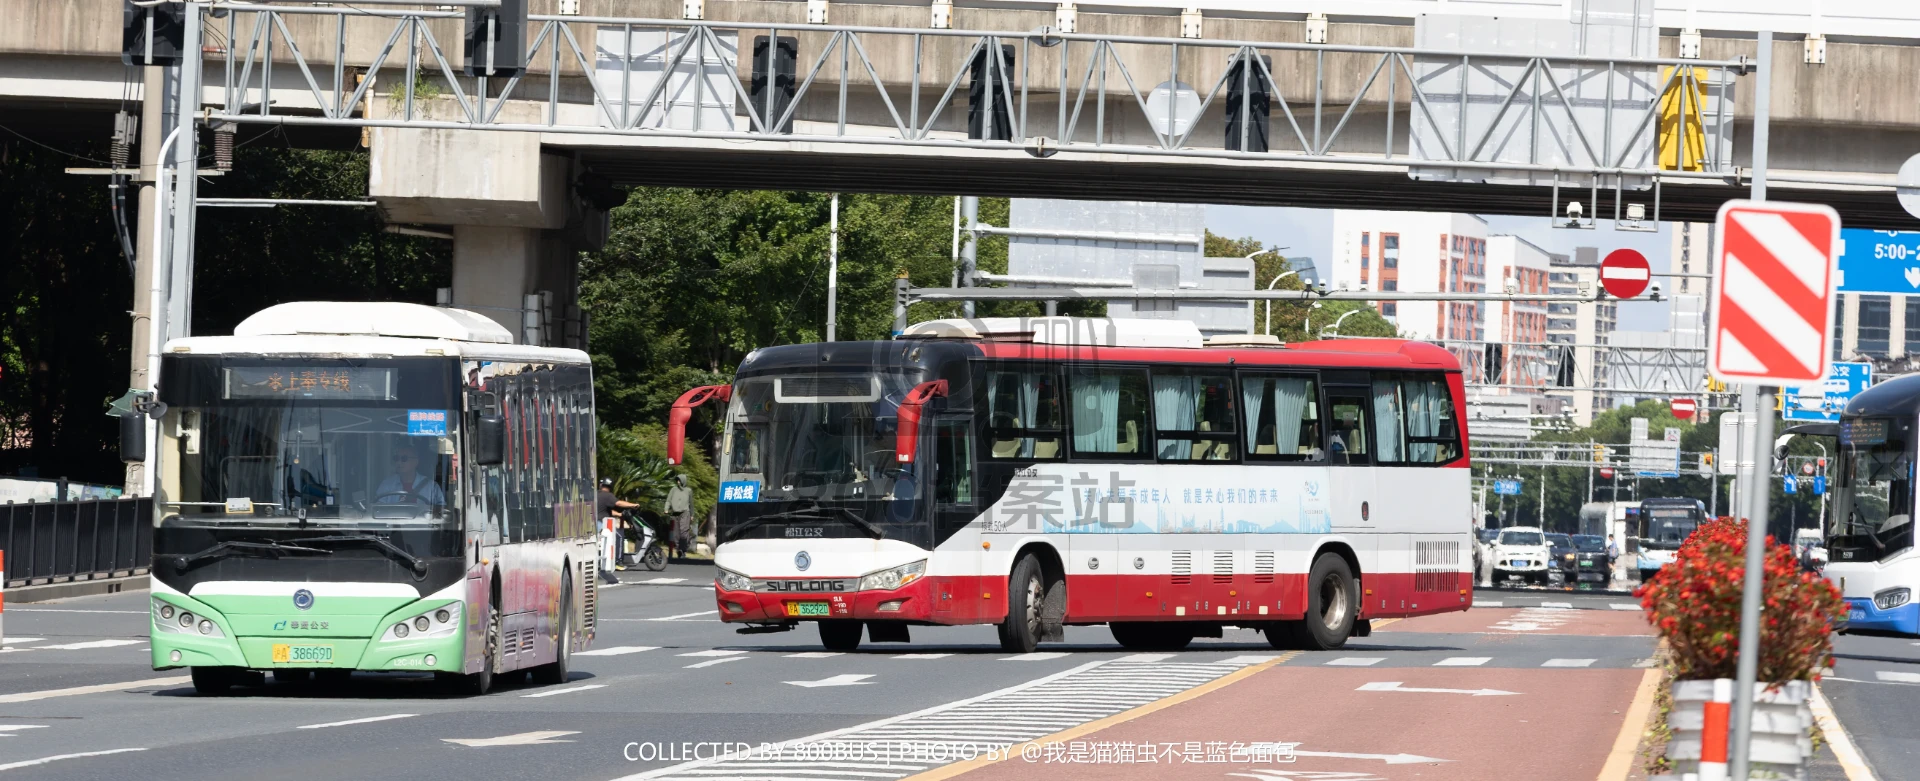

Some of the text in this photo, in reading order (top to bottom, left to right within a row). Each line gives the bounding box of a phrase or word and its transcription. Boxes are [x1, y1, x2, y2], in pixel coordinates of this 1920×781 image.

[724, 484, 754, 500] 南松线
[785, 527, 824, 537] 松江公交
[766, 580, 845, 592] SUNLONG
